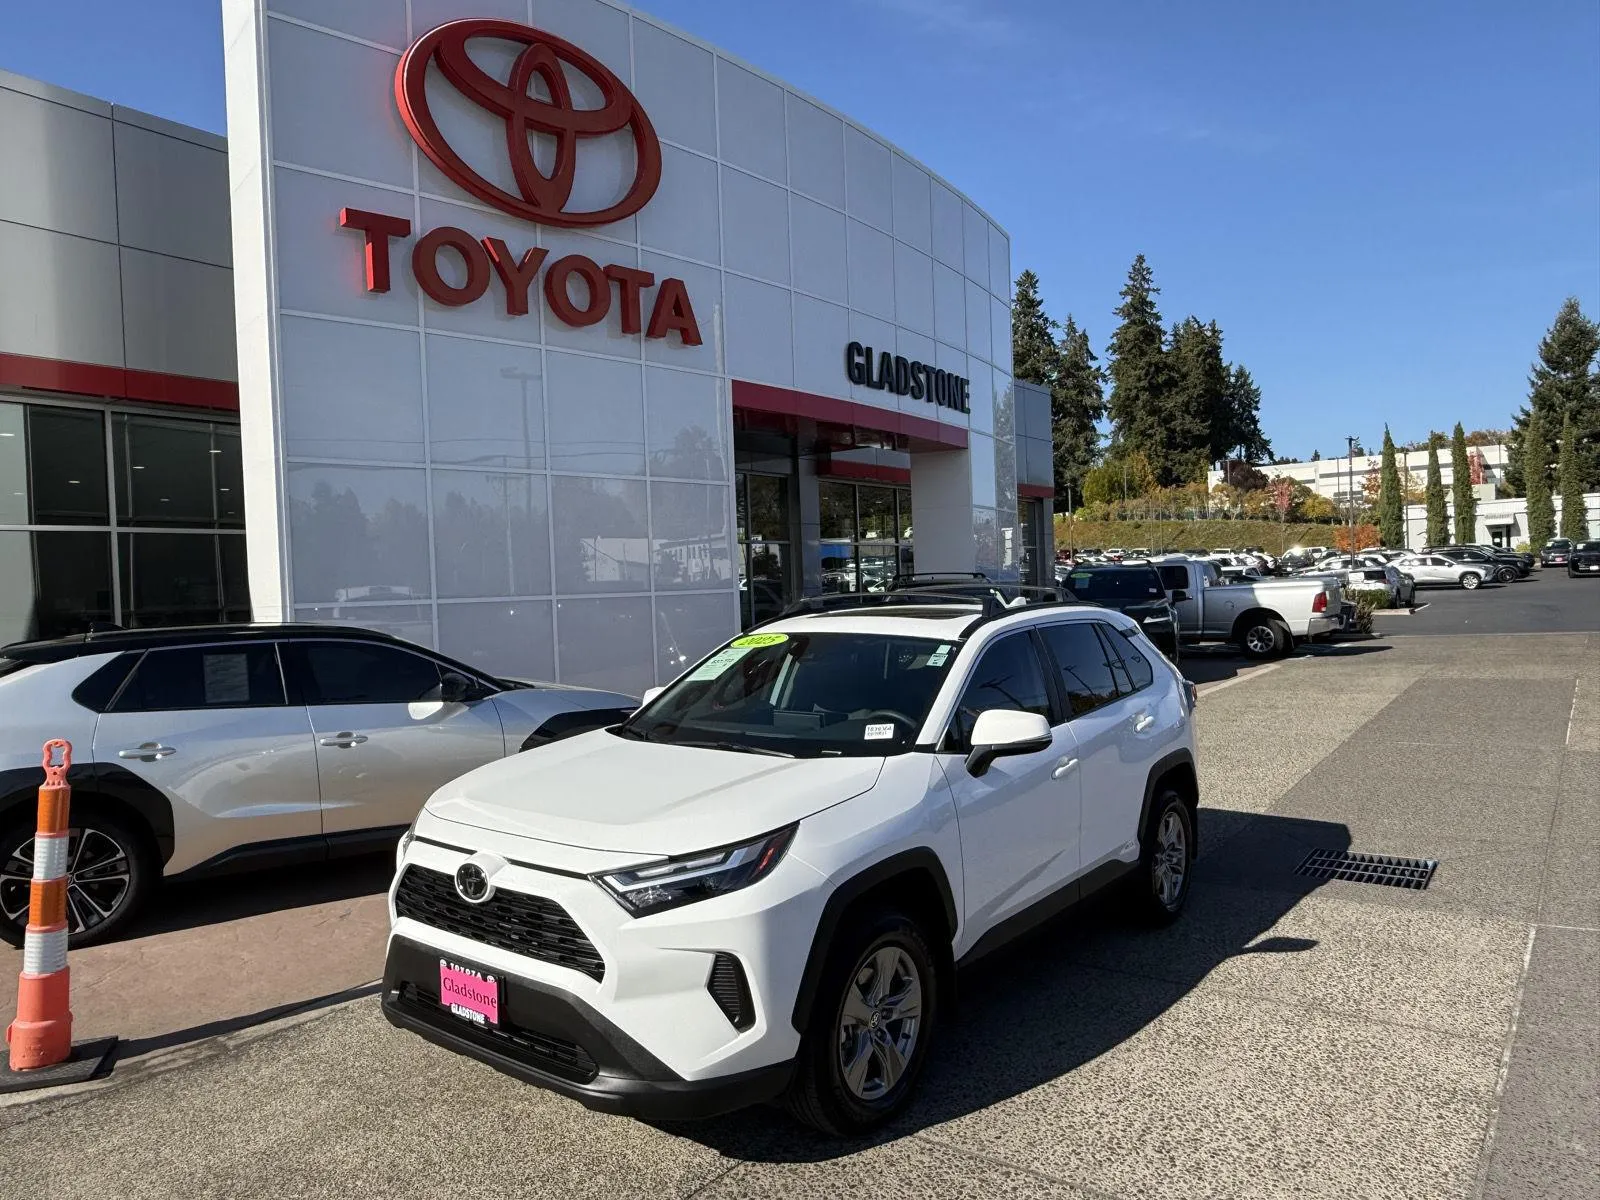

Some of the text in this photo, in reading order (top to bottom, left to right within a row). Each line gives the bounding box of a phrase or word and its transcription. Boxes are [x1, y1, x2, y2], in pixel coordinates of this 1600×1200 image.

[340, 207, 703, 346] TOYOTA
[846, 341, 971, 414] GLADSTONE
[443, 977, 497, 1008] Gladstone
[451, 1003, 485, 1024] GLADSTONE
